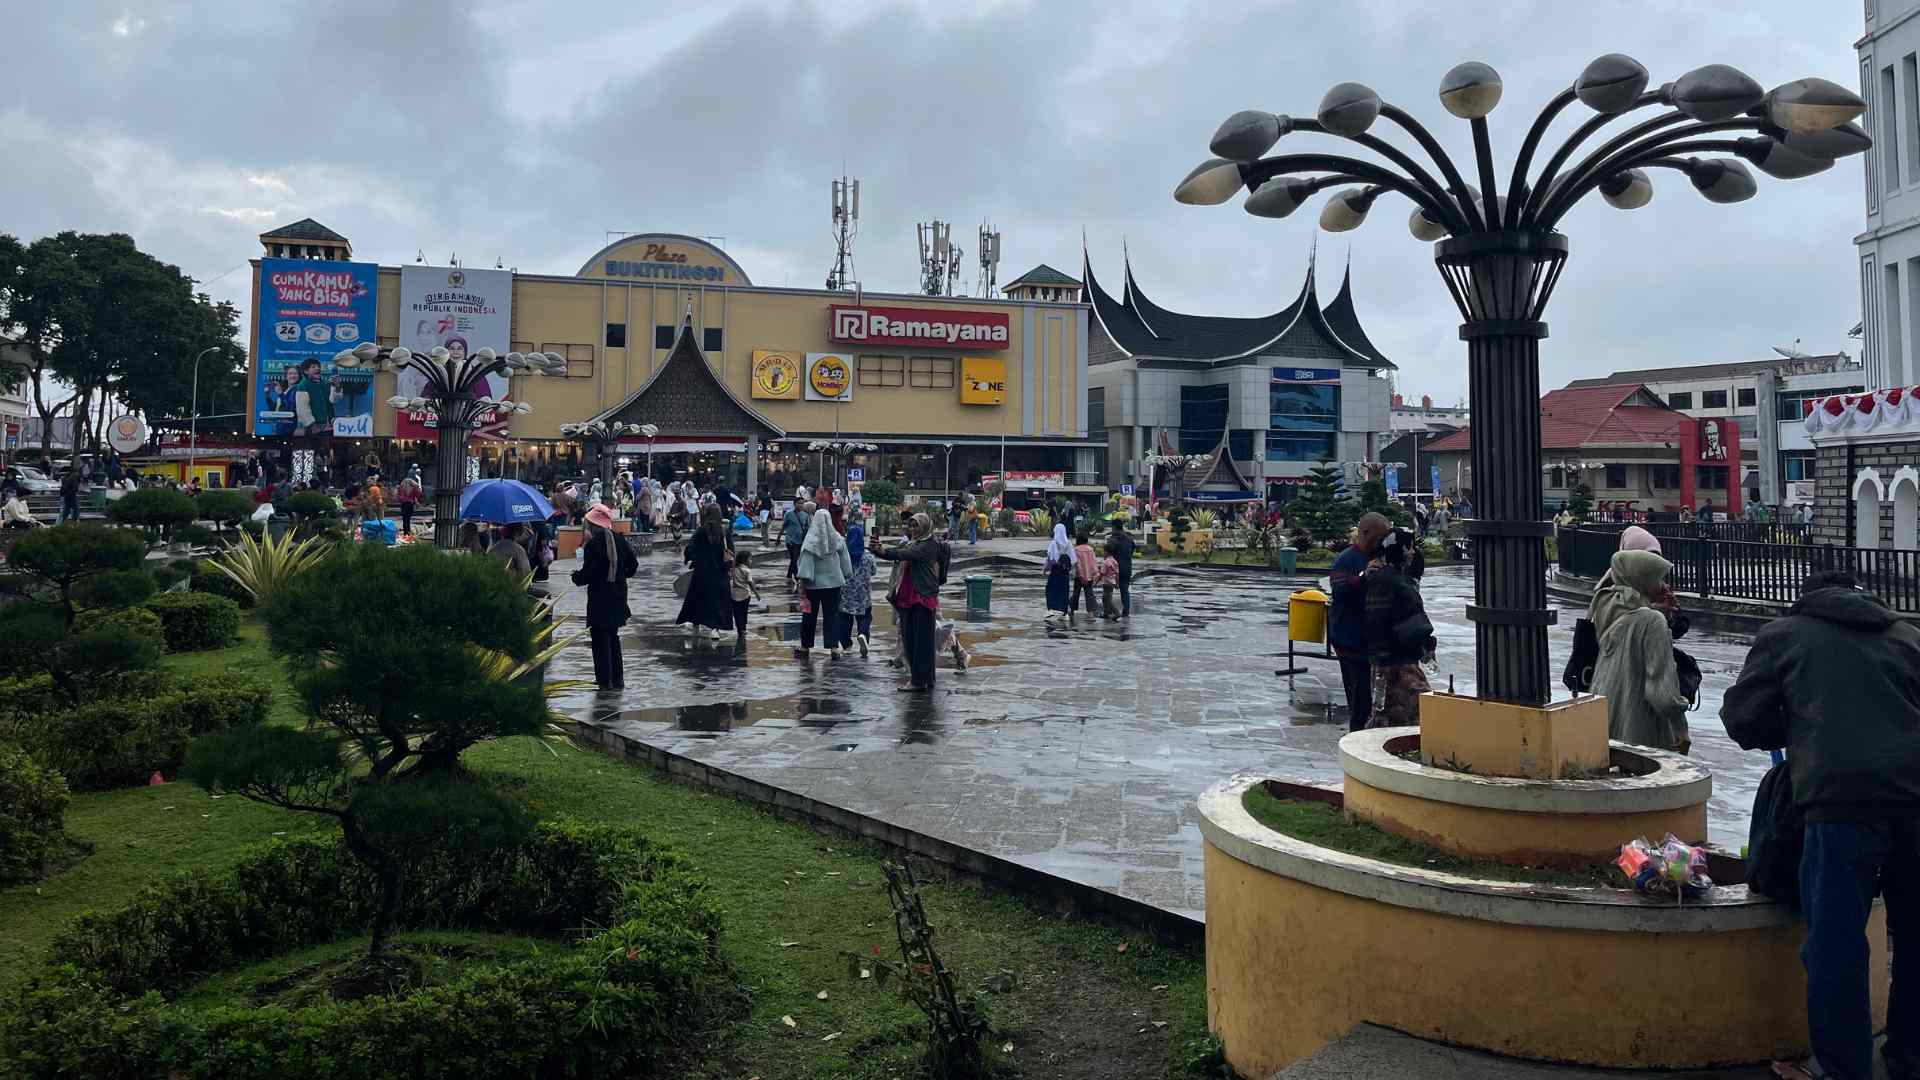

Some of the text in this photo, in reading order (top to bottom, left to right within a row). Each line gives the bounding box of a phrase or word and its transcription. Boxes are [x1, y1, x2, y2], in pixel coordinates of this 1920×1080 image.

[279, 287, 311, 302] YANG
[425, 292, 484, 304] DIRGAHAYU
[412, 303, 497, 314] REPUBLIK INDONESIA
[279, 325, 296, 335] 24
[870, 315, 1008, 343] Ramayana
